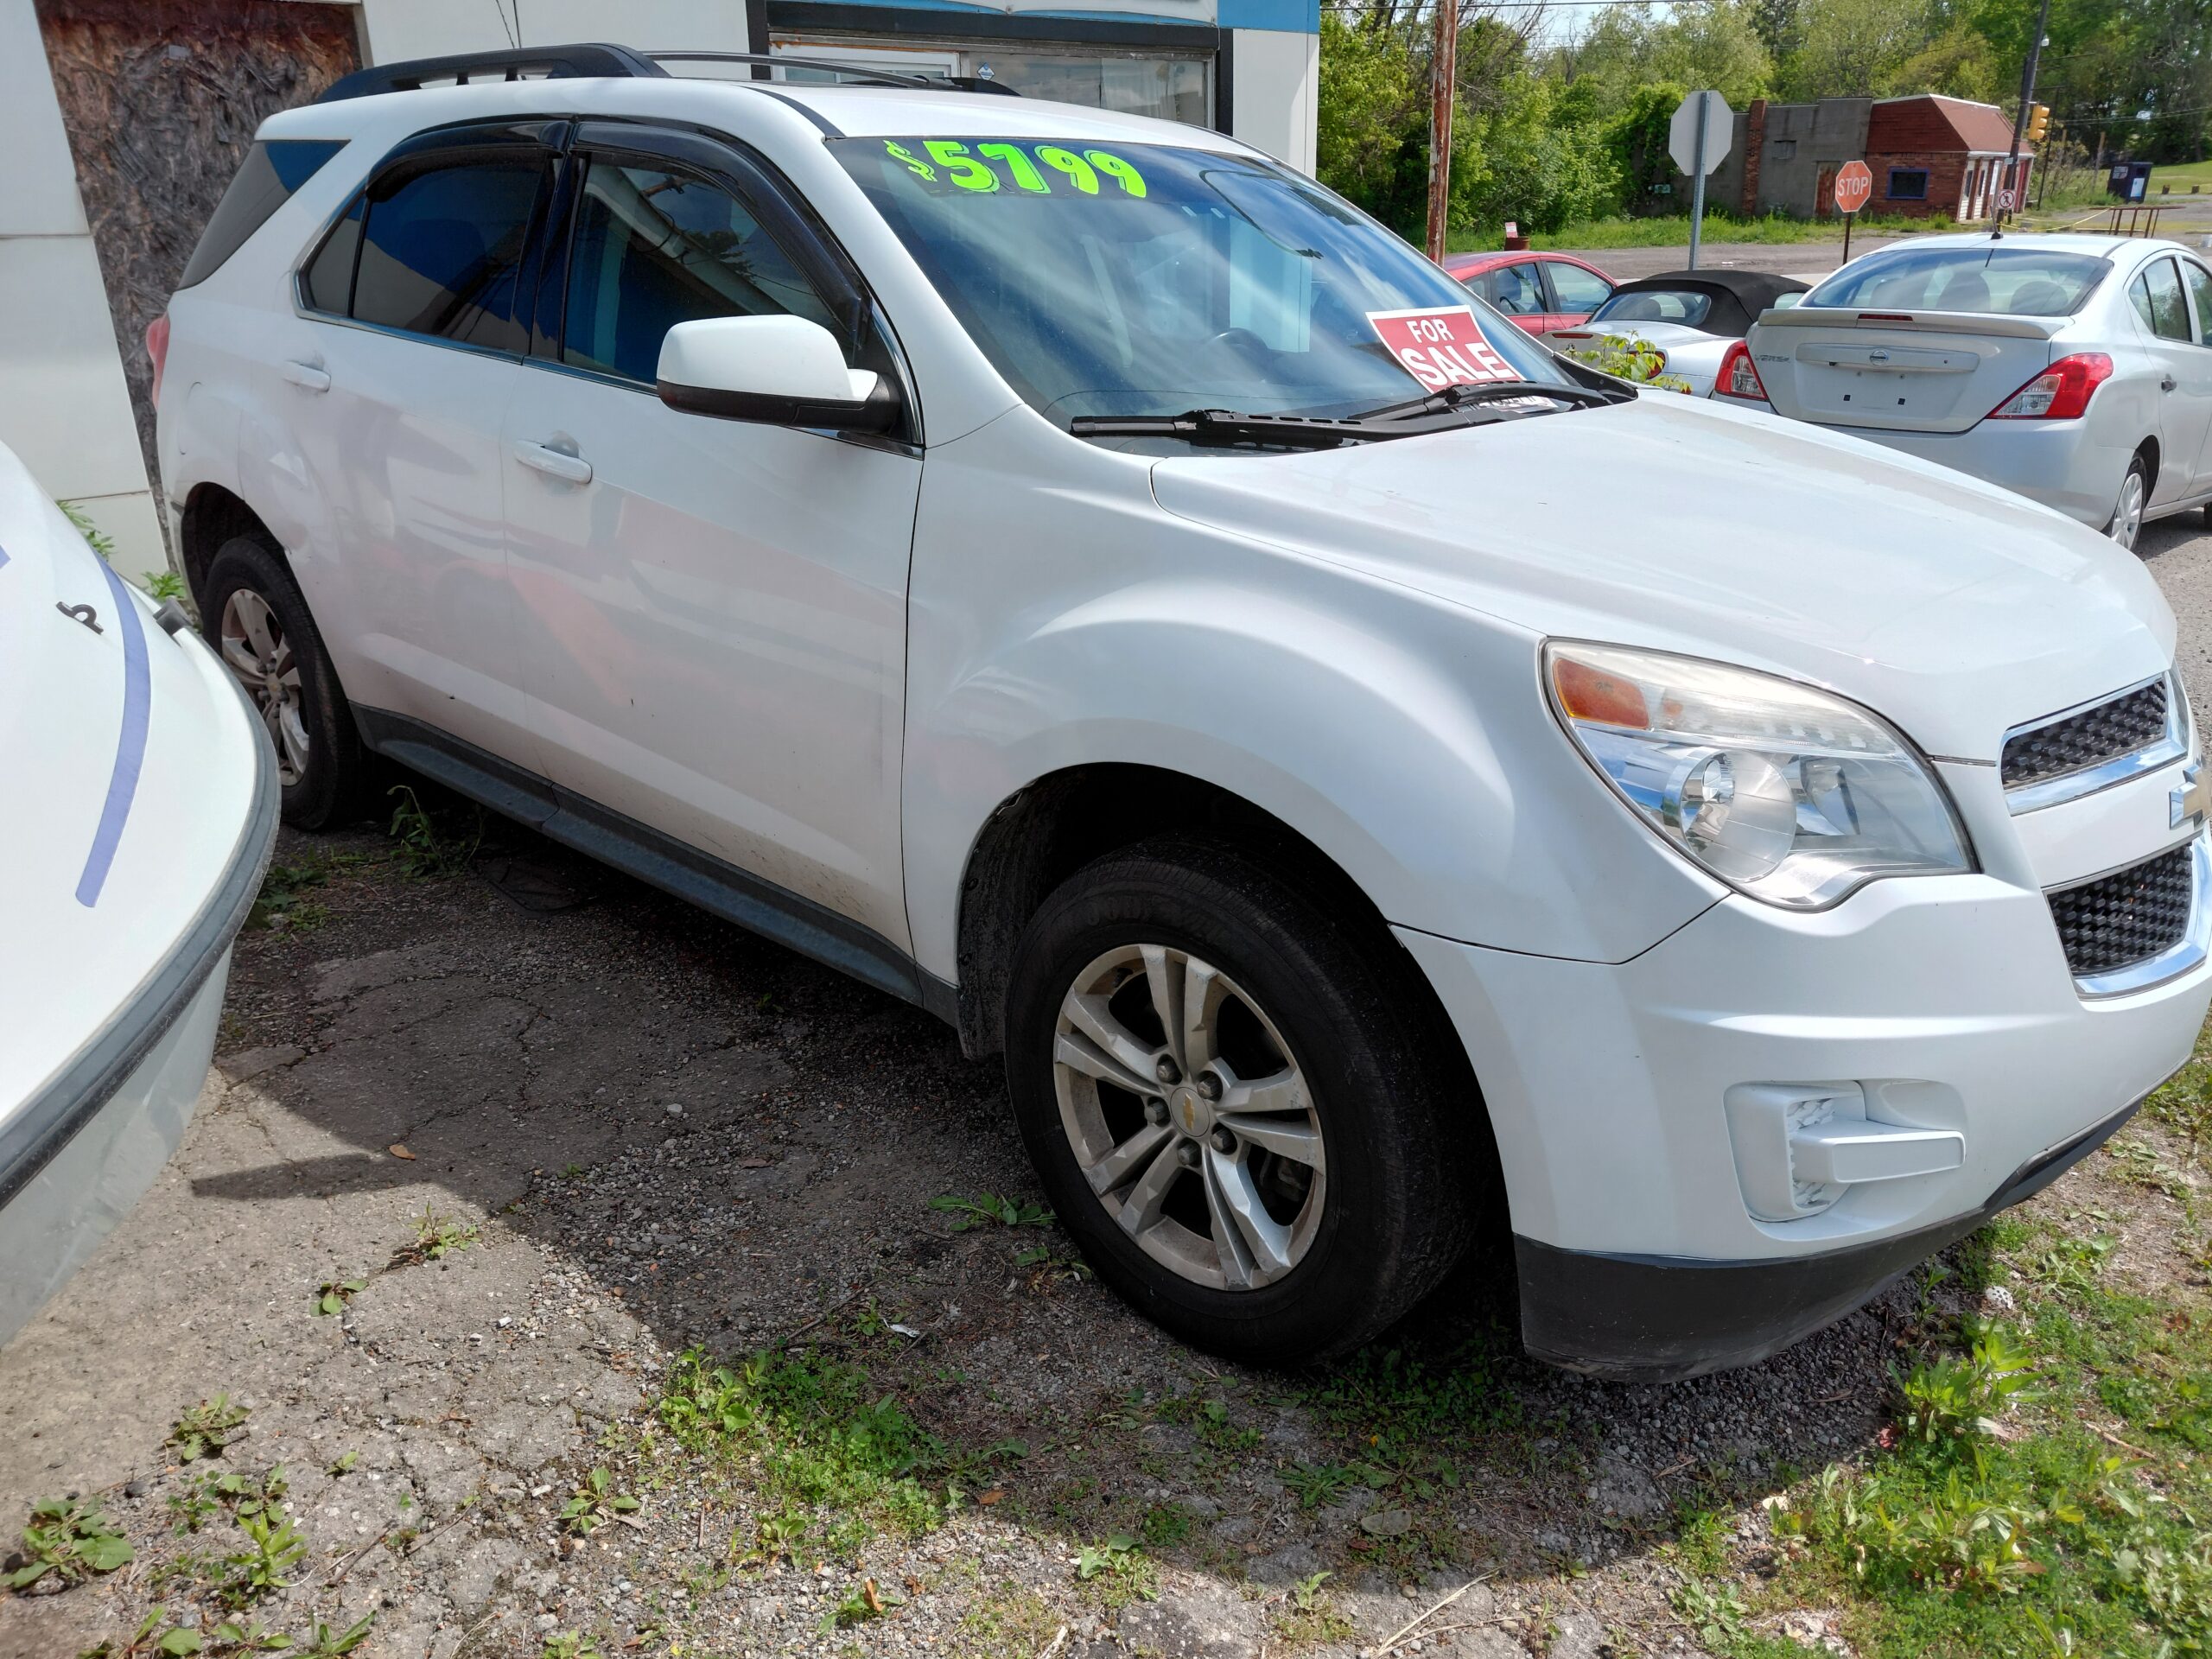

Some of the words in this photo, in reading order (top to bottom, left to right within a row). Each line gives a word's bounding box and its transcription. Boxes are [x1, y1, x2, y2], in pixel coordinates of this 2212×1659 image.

[883, 140, 1147, 198] $5799
[1838, 176, 1869, 197] STOP
[1406, 319, 1455, 344] FOR
[1401, 342, 1516, 385] SALE
